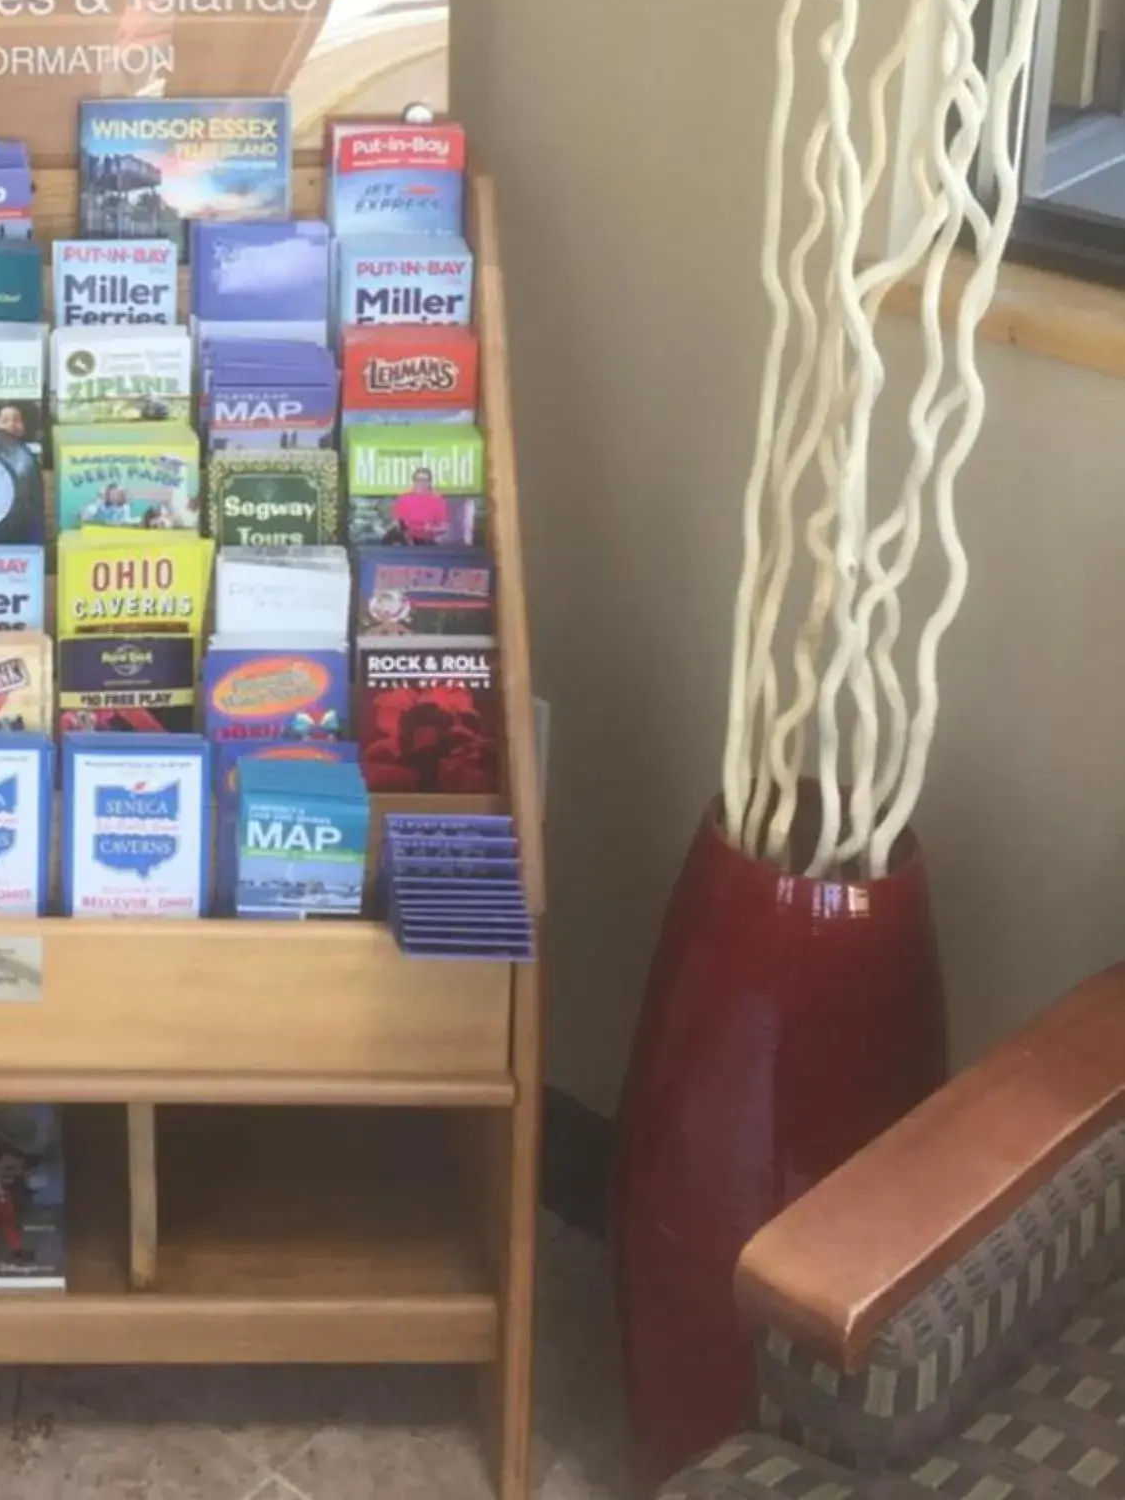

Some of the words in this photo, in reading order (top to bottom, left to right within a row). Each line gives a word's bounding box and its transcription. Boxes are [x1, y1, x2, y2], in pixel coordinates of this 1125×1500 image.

[91, 118, 206, 139] WINDSOR
[210, 118, 278, 138] ESSEX
[63, 247, 169, 263] PUT-IN-BAY
[356, 261, 465, 276] PUT-IN-BAY
[63, 274, 169, 304] Miller
[356, 288, 464, 314] Miller
[65, 305, 167, 326] Ferries
[215, 401, 304, 421] MAP
[356, 445, 474, 488] Mansfield
[225, 496, 315, 522] Segway
[237, 527, 302, 545] Tours
[92, 558, 173, 592] OHIO
[74, 596, 193, 618] CAVERNS
[368, 655, 420, 671] ROCK
[425, 655, 437, 671] &
[442, 655, 490, 671] ROLL
[247, 821, 342, 852] MAP
